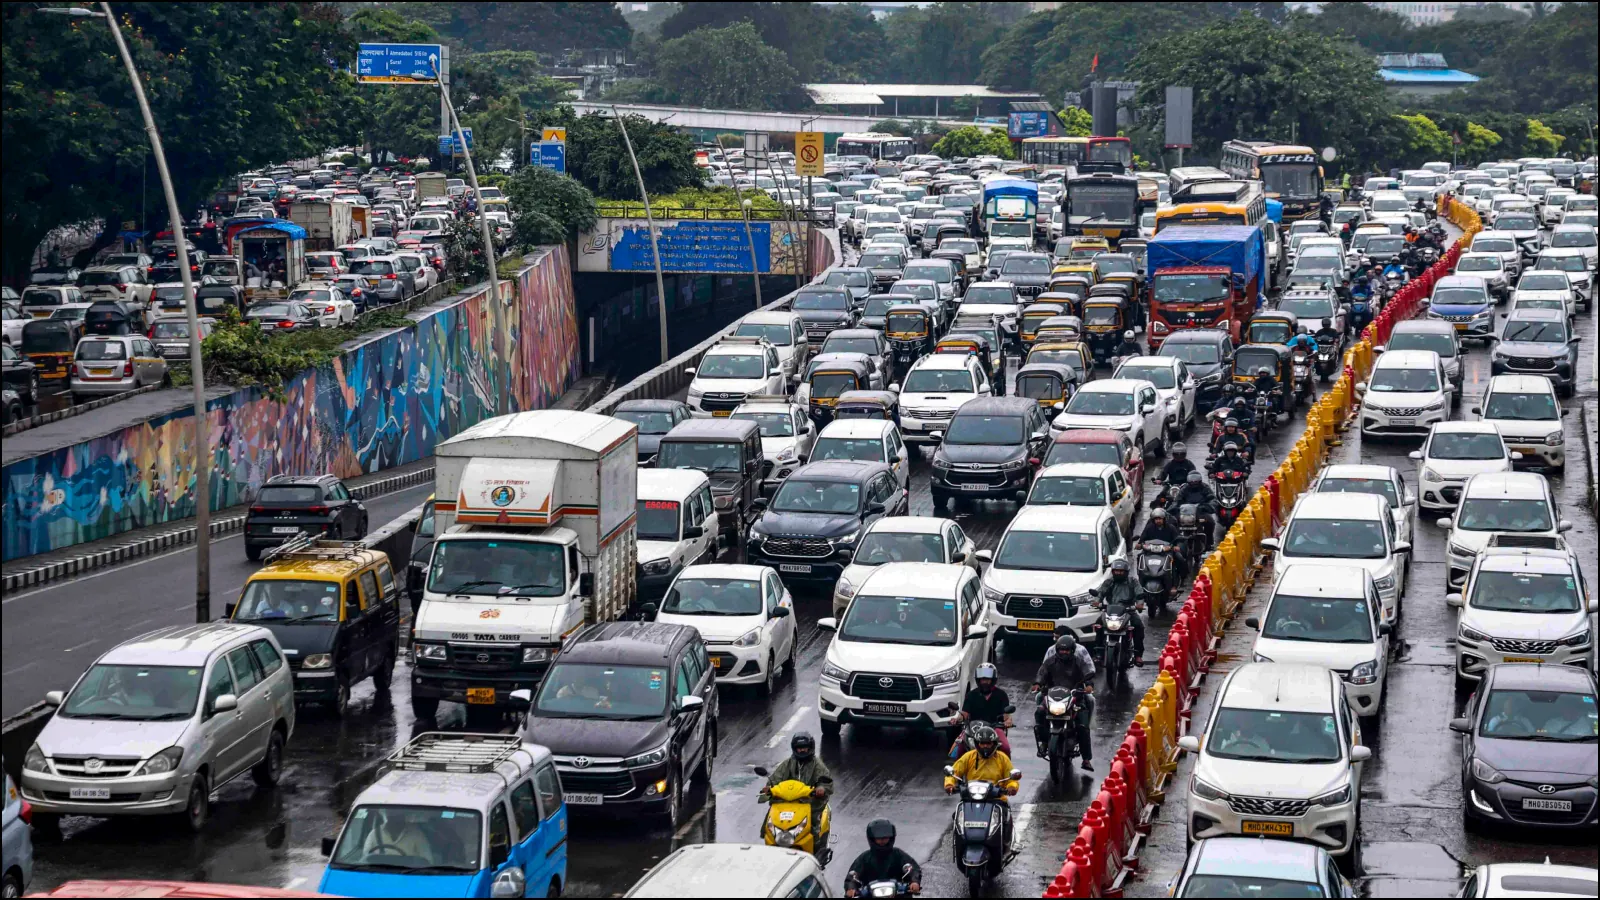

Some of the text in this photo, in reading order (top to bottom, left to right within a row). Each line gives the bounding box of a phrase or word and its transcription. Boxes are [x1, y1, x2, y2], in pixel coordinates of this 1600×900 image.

[1262, 154, 1314, 163] Tirth
[645, 501, 678, 510] ESCORT
[1528, 801, 1570, 810] MH03BS0526
